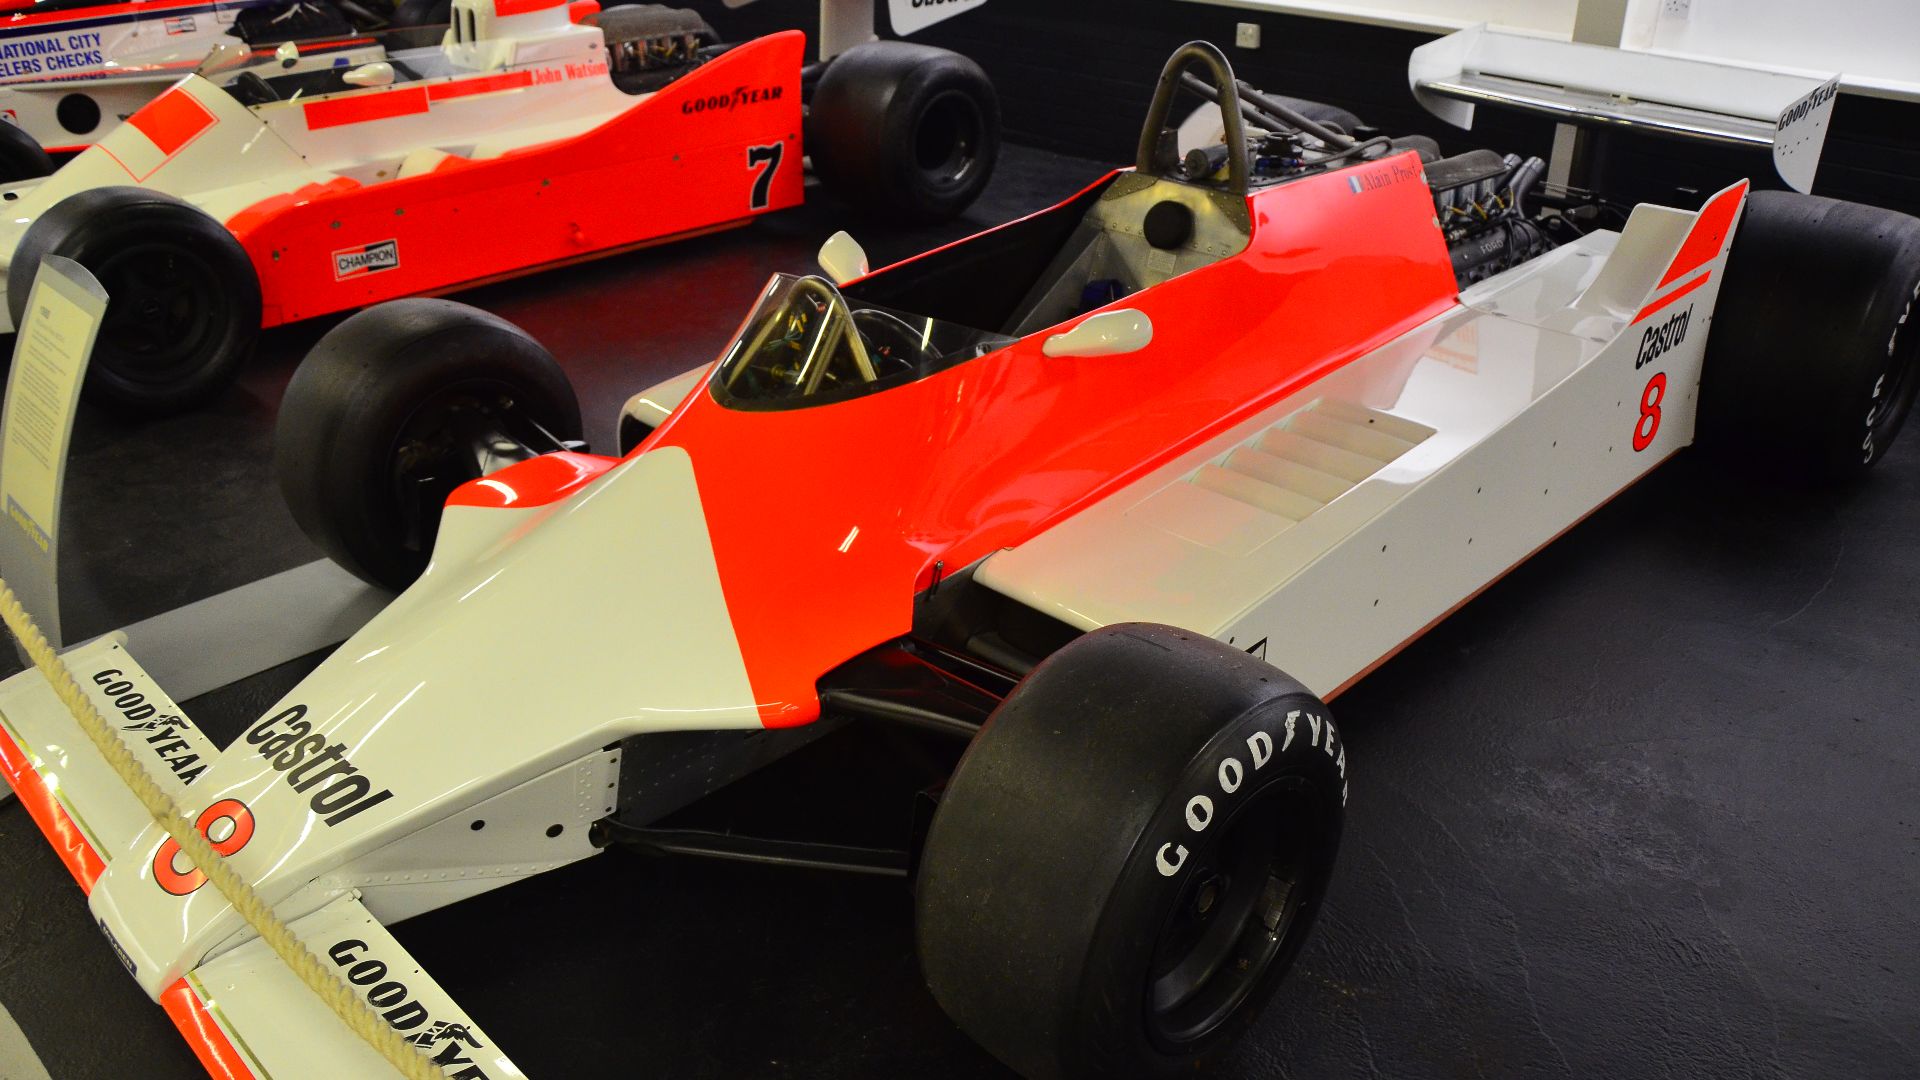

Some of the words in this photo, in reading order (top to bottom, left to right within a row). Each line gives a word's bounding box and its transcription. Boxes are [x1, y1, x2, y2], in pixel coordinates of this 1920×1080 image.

[68, 32, 101, 51] CITY
[47, 50, 103, 73] CHECKS
[535, 66, 562, 84] John
[564, 63, 608, 80] Watson
[682, 85, 783, 114] GOODYEAR
[747, 140, 784, 211] 7
[1364, 169, 1392, 191] Alain
[1392, 164, 1418, 184] Prost
[338, 248, 394, 270] CHAMPION
[1480, 239, 1504, 255] FORD
[1636, 303, 1694, 370] Castrol
[1633, 372, 1667, 453] 8
[246, 704, 394, 828] Castrol
[152, 798, 255, 896] 8
